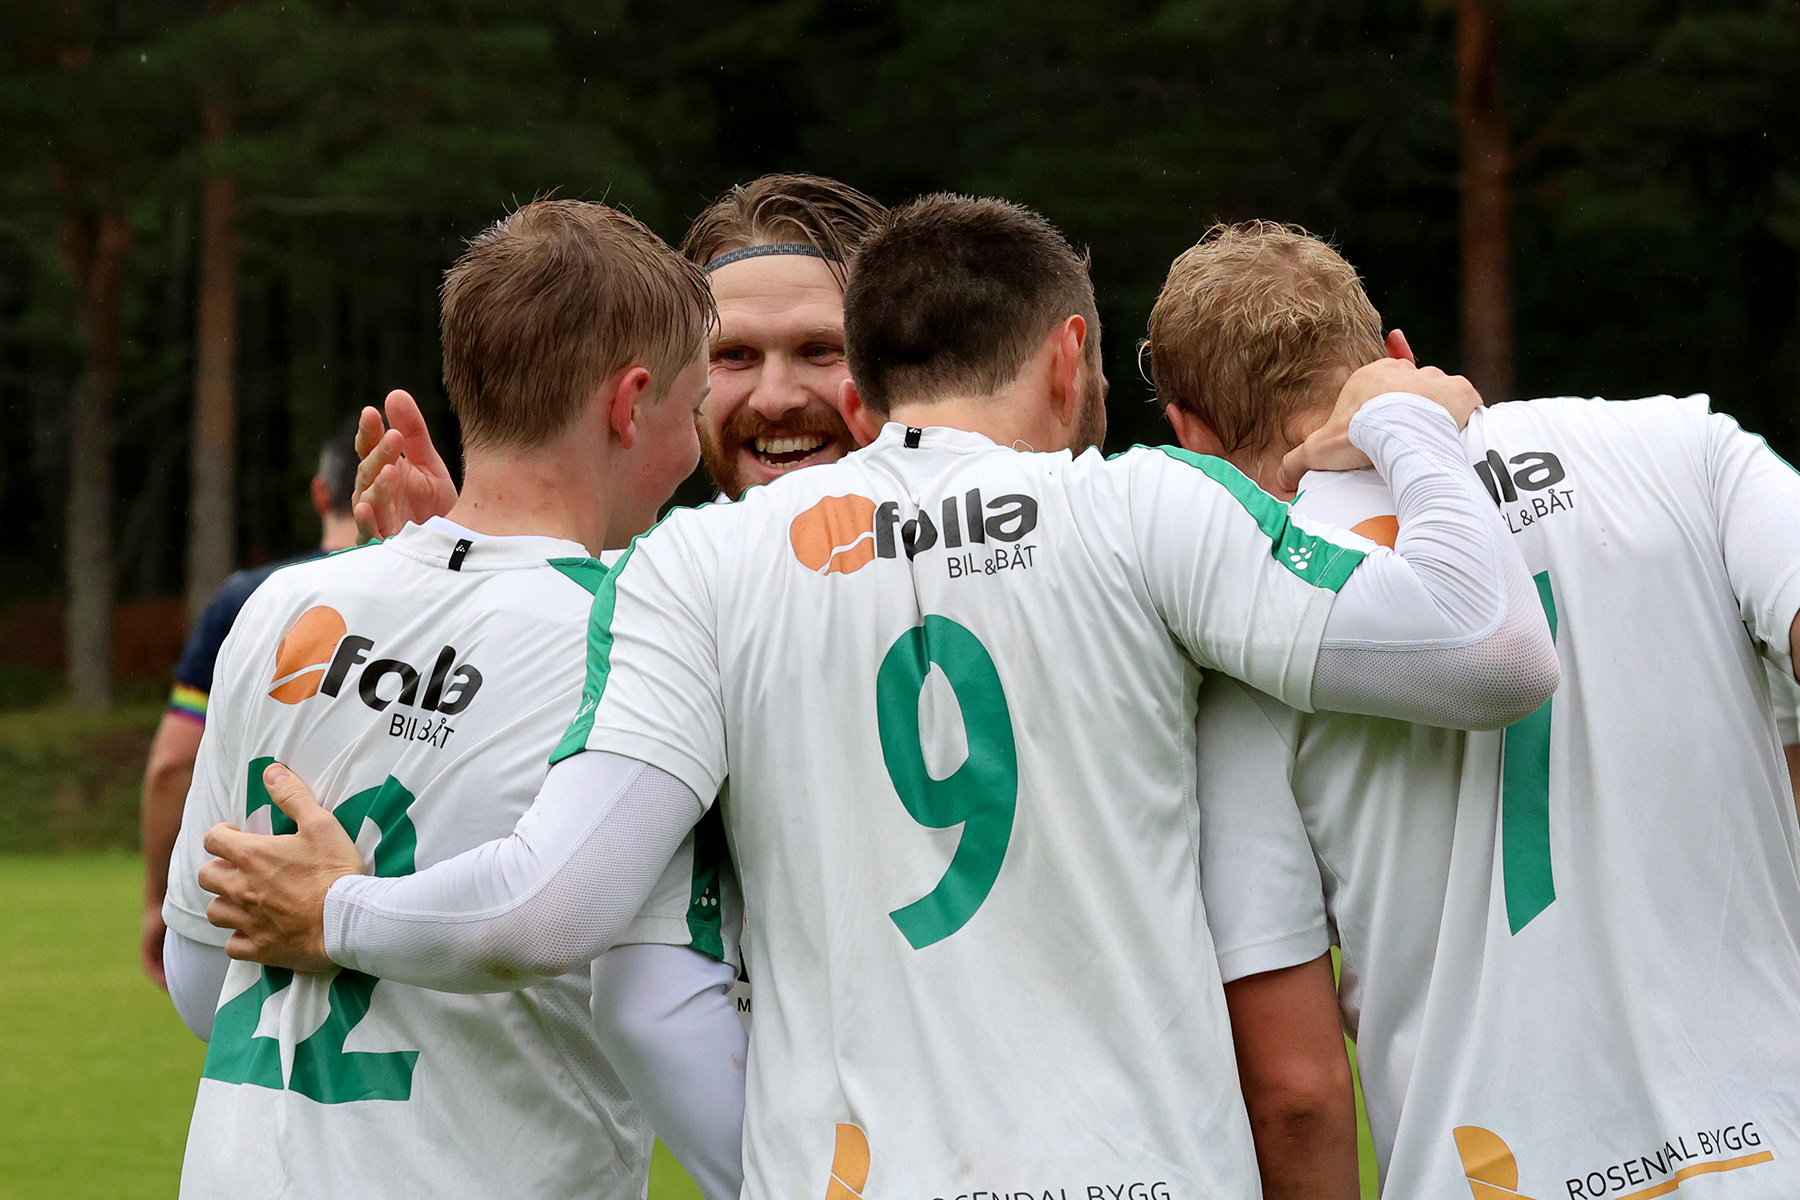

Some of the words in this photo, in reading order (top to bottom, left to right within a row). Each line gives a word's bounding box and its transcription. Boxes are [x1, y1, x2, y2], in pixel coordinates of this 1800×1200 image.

[1473, 449, 1566, 509] lla
[876, 488, 1038, 562] folla
[877, 614, 1018, 950] 9
[1087, 1181, 1170, 1200] BYGG
[1566, 1136, 1698, 1200] ROSENAL
[1697, 1122, 1762, 1155] BYGG
